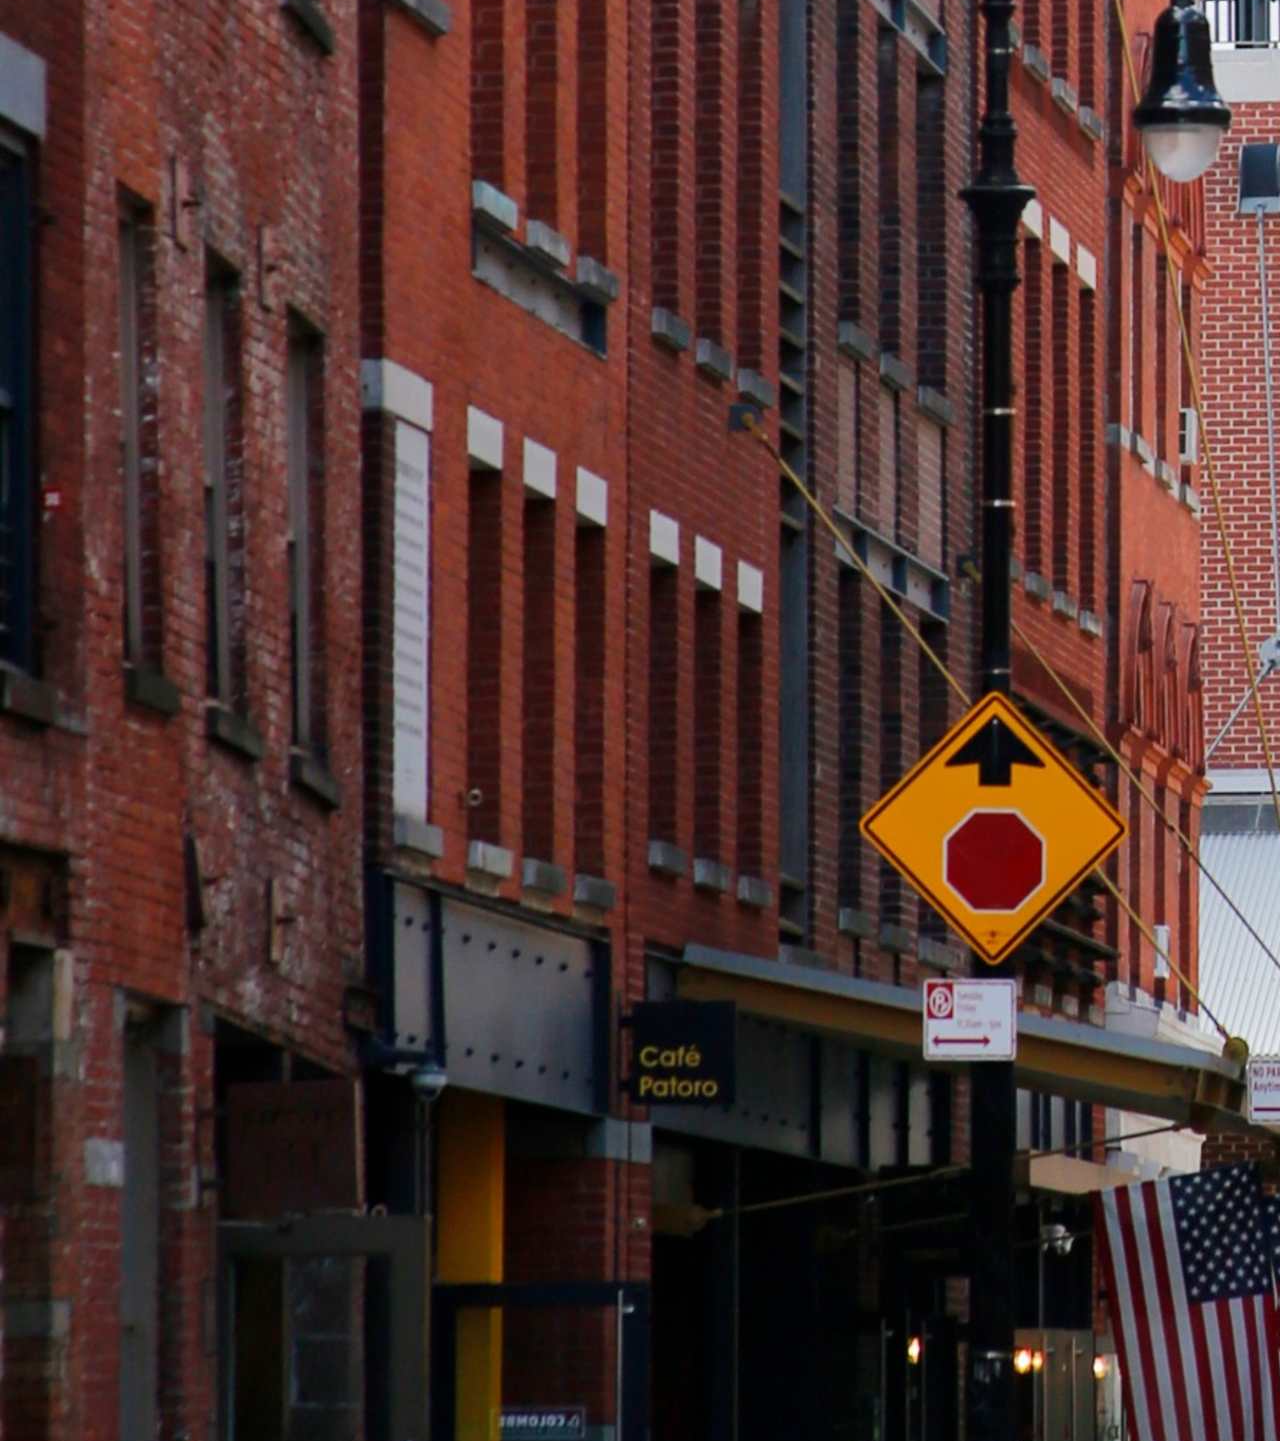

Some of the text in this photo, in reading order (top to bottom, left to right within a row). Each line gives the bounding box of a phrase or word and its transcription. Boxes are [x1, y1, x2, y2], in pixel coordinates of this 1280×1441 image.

[640, 1044, 701, 1068] Café
[1252, 1067, 1264, 1077] NO
[640, 1075, 718, 1098] Patoro
